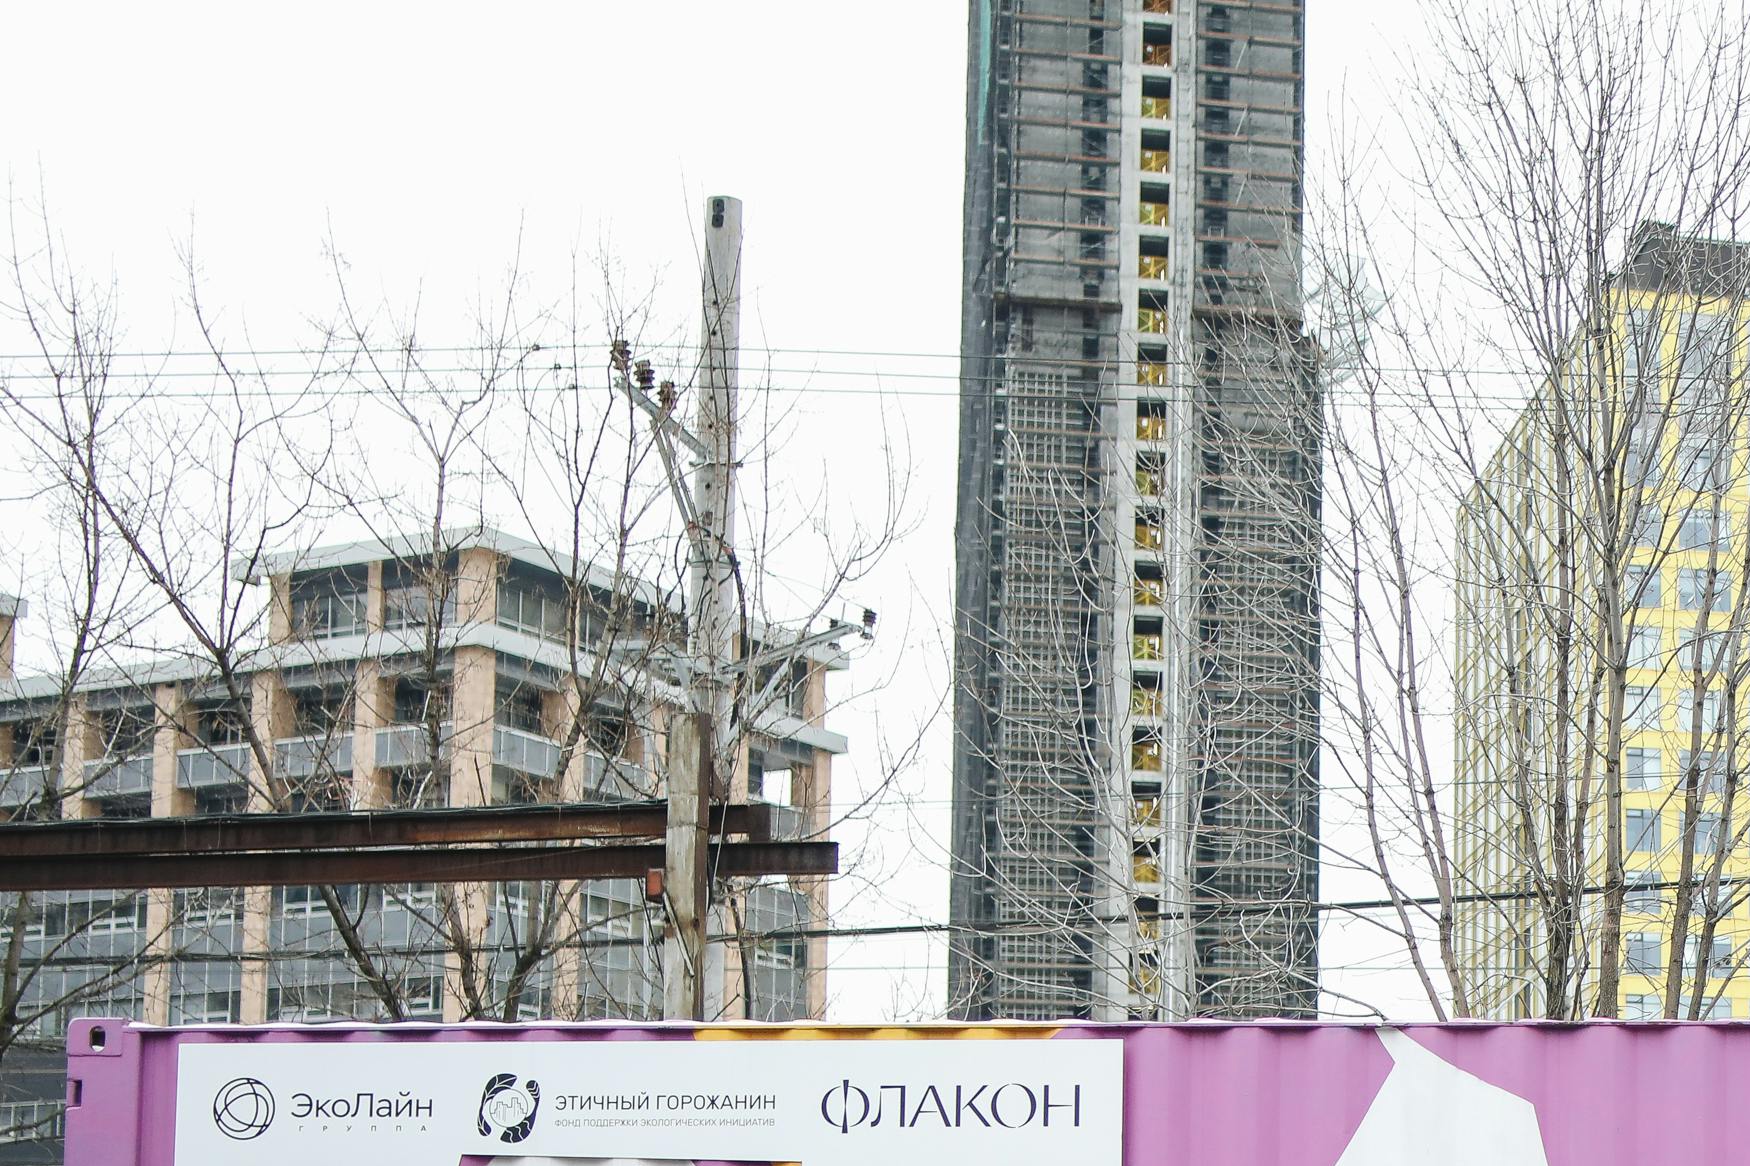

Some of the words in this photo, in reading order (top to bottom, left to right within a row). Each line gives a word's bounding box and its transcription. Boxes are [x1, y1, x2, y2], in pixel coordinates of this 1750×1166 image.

[291, 1091, 433, 1118] ЭкоЛайн
[555, 1092, 650, 1111] ЭТИЧНЫЙ
[656, 1095, 777, 1111] ГОРОЖАНИН
[821, 1079, 1081, 1134] ФЛАКОН
[555, 1118, 581, 1127] ФОНД
[583, 1118, 638, 1127] ПОДДЕРЖКИ
[640, 1118, 717, 1127] ЭКОЛОГИЧЕСКИХ
[719, 1118, 775, 1127] ИНИЦИАТИВ
